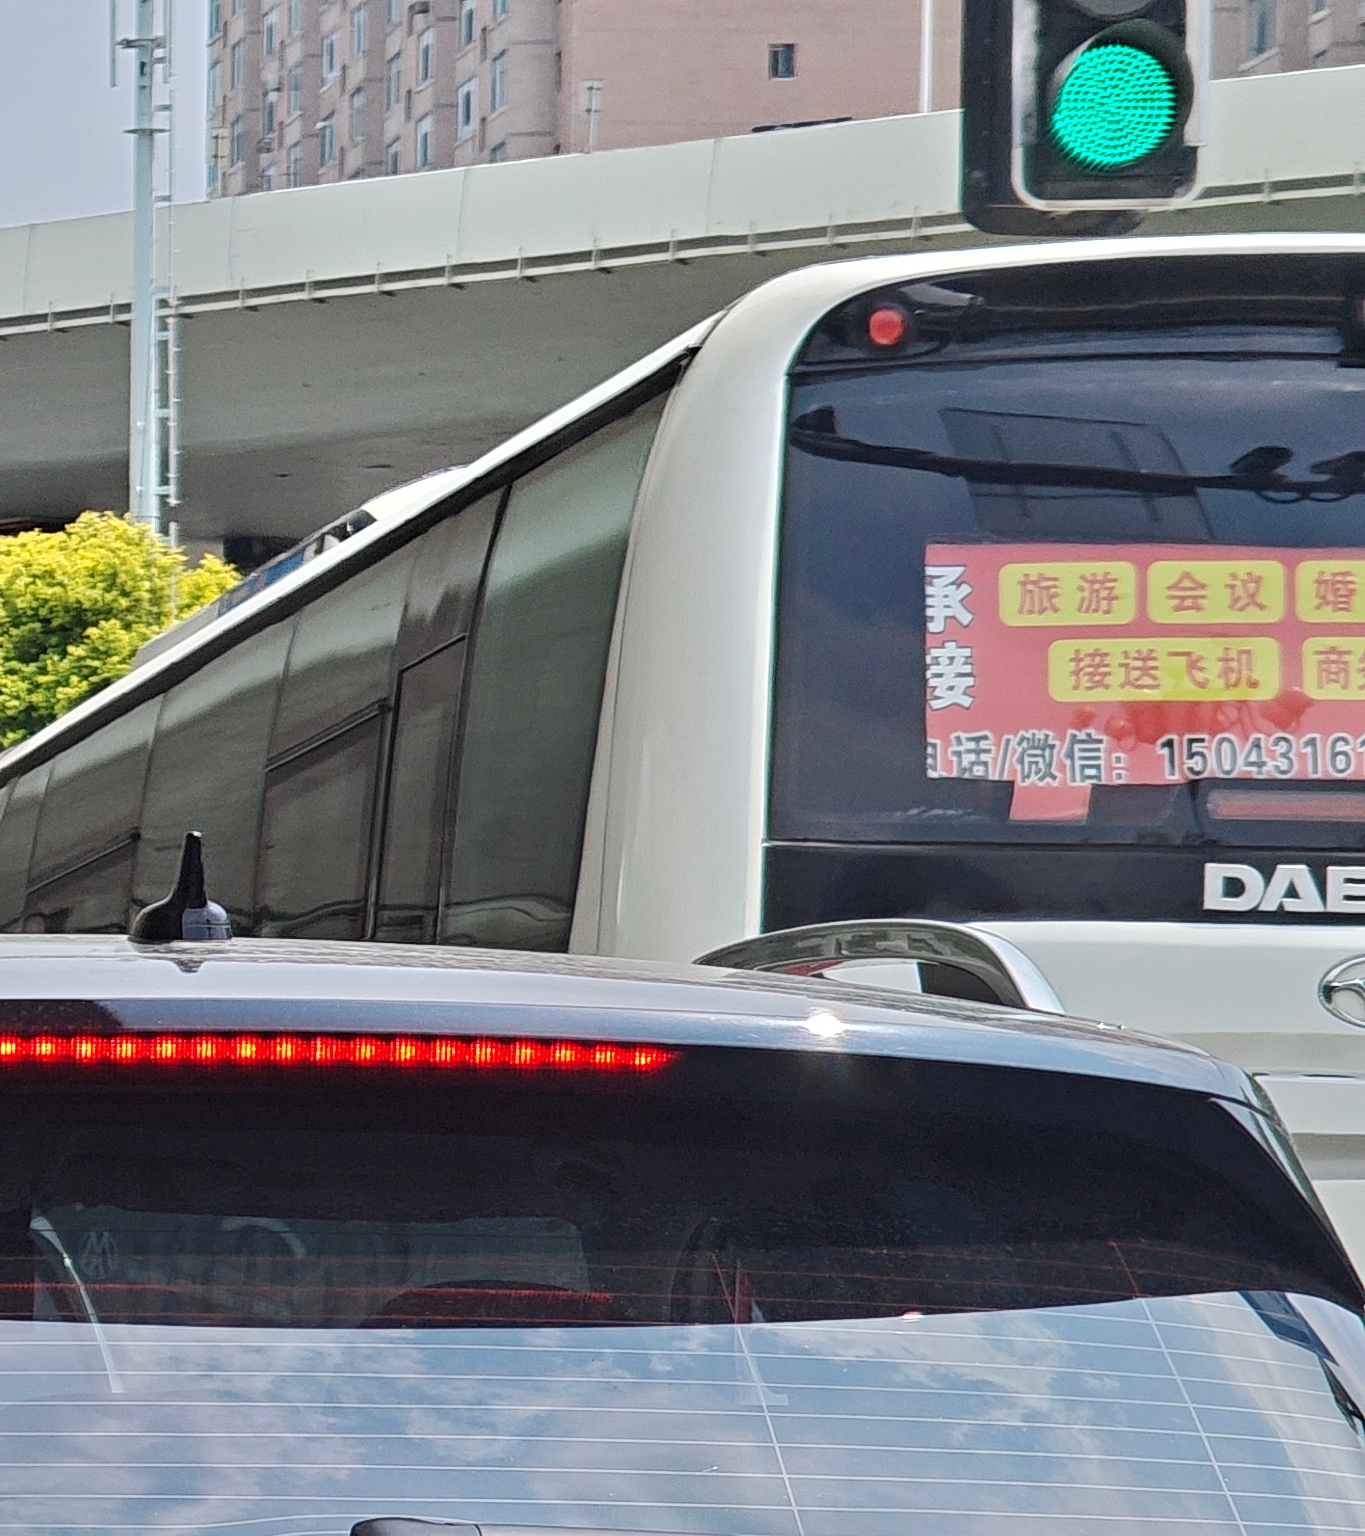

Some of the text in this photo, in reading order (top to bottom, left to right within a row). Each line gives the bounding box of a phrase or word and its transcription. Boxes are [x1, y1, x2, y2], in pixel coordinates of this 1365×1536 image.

[1016, 570, 1358, 616] 旅游 会议 婚
[1069, 646, 1365, 691] 接送飞机 商
